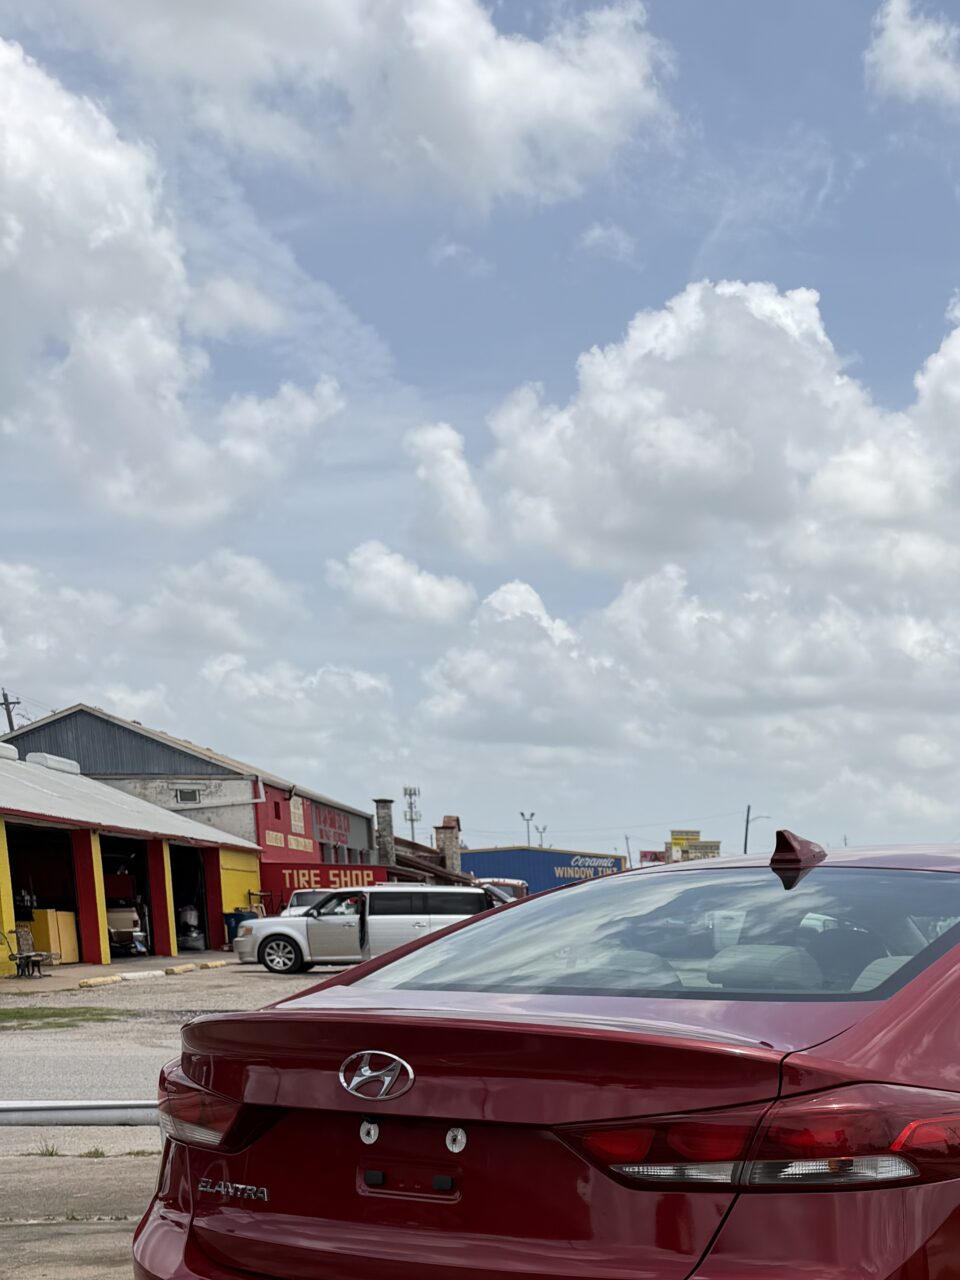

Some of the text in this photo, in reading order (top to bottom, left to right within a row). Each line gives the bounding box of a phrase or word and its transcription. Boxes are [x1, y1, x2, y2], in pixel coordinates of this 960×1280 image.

[570, 855, 615, 867] Ceramic
[282, 869, 374, 888] TIRE SHOP
[554, 866, 594, 879] WINDOW
[198, 1177, 268, 1202] ELANTRA
